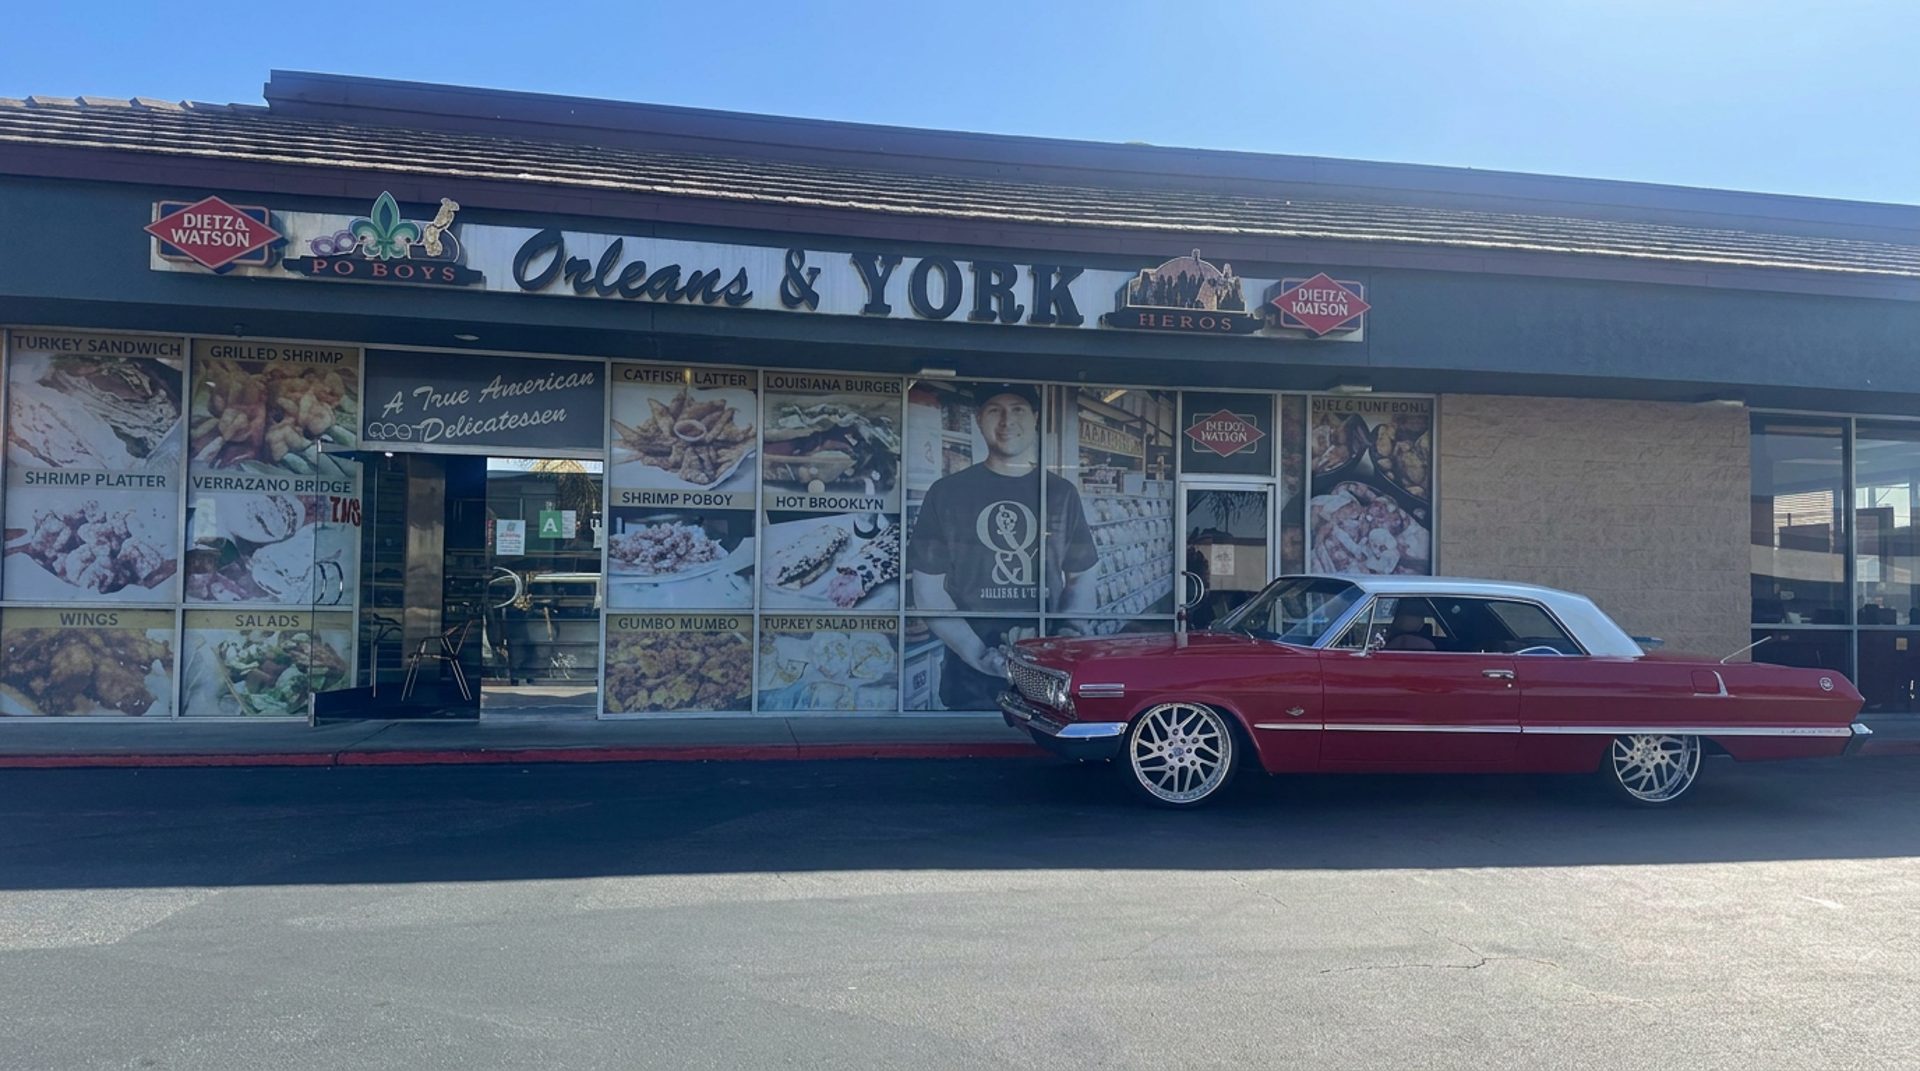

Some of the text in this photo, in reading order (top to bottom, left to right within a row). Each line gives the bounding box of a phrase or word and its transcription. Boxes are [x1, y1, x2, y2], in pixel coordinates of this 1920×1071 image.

[171, 228, 250, 248] WATSON
[311, 259, 456, 281] PO BOYS
[512, 228, 1086, 327] Orleans & YORK
[1138, 312, 1232, 331] HEROS
[14, 335, 182, 357] TURKEY SANDWICH
[210, 345, 344, 364] GRILLED SHRIMP
[690, 371, 748, 387] LATTER
[766, 375, 842, 391] LOUISIANA
[381, 371, 596, 418] A True American
[421, 407, 568, 442] Delicatessen
[25, 471, 166, 488] SHRIMP PLATTER
[192, 475, 352, 494] VERRAZANO BRIDGE
[622, 491, 733, 507] SHRIMP POBOY
[776, 496, 884, 511] HOT BROOKLYN
[542, 517, 558, 533] A
[59, 612, 118, 626] WINGS
[235, 615, 300, 628] SALADS
[618, 617, 739, 630] GUMBO MUMBO
[763, 617, 897, 630] TURKEY SALAD HERO
